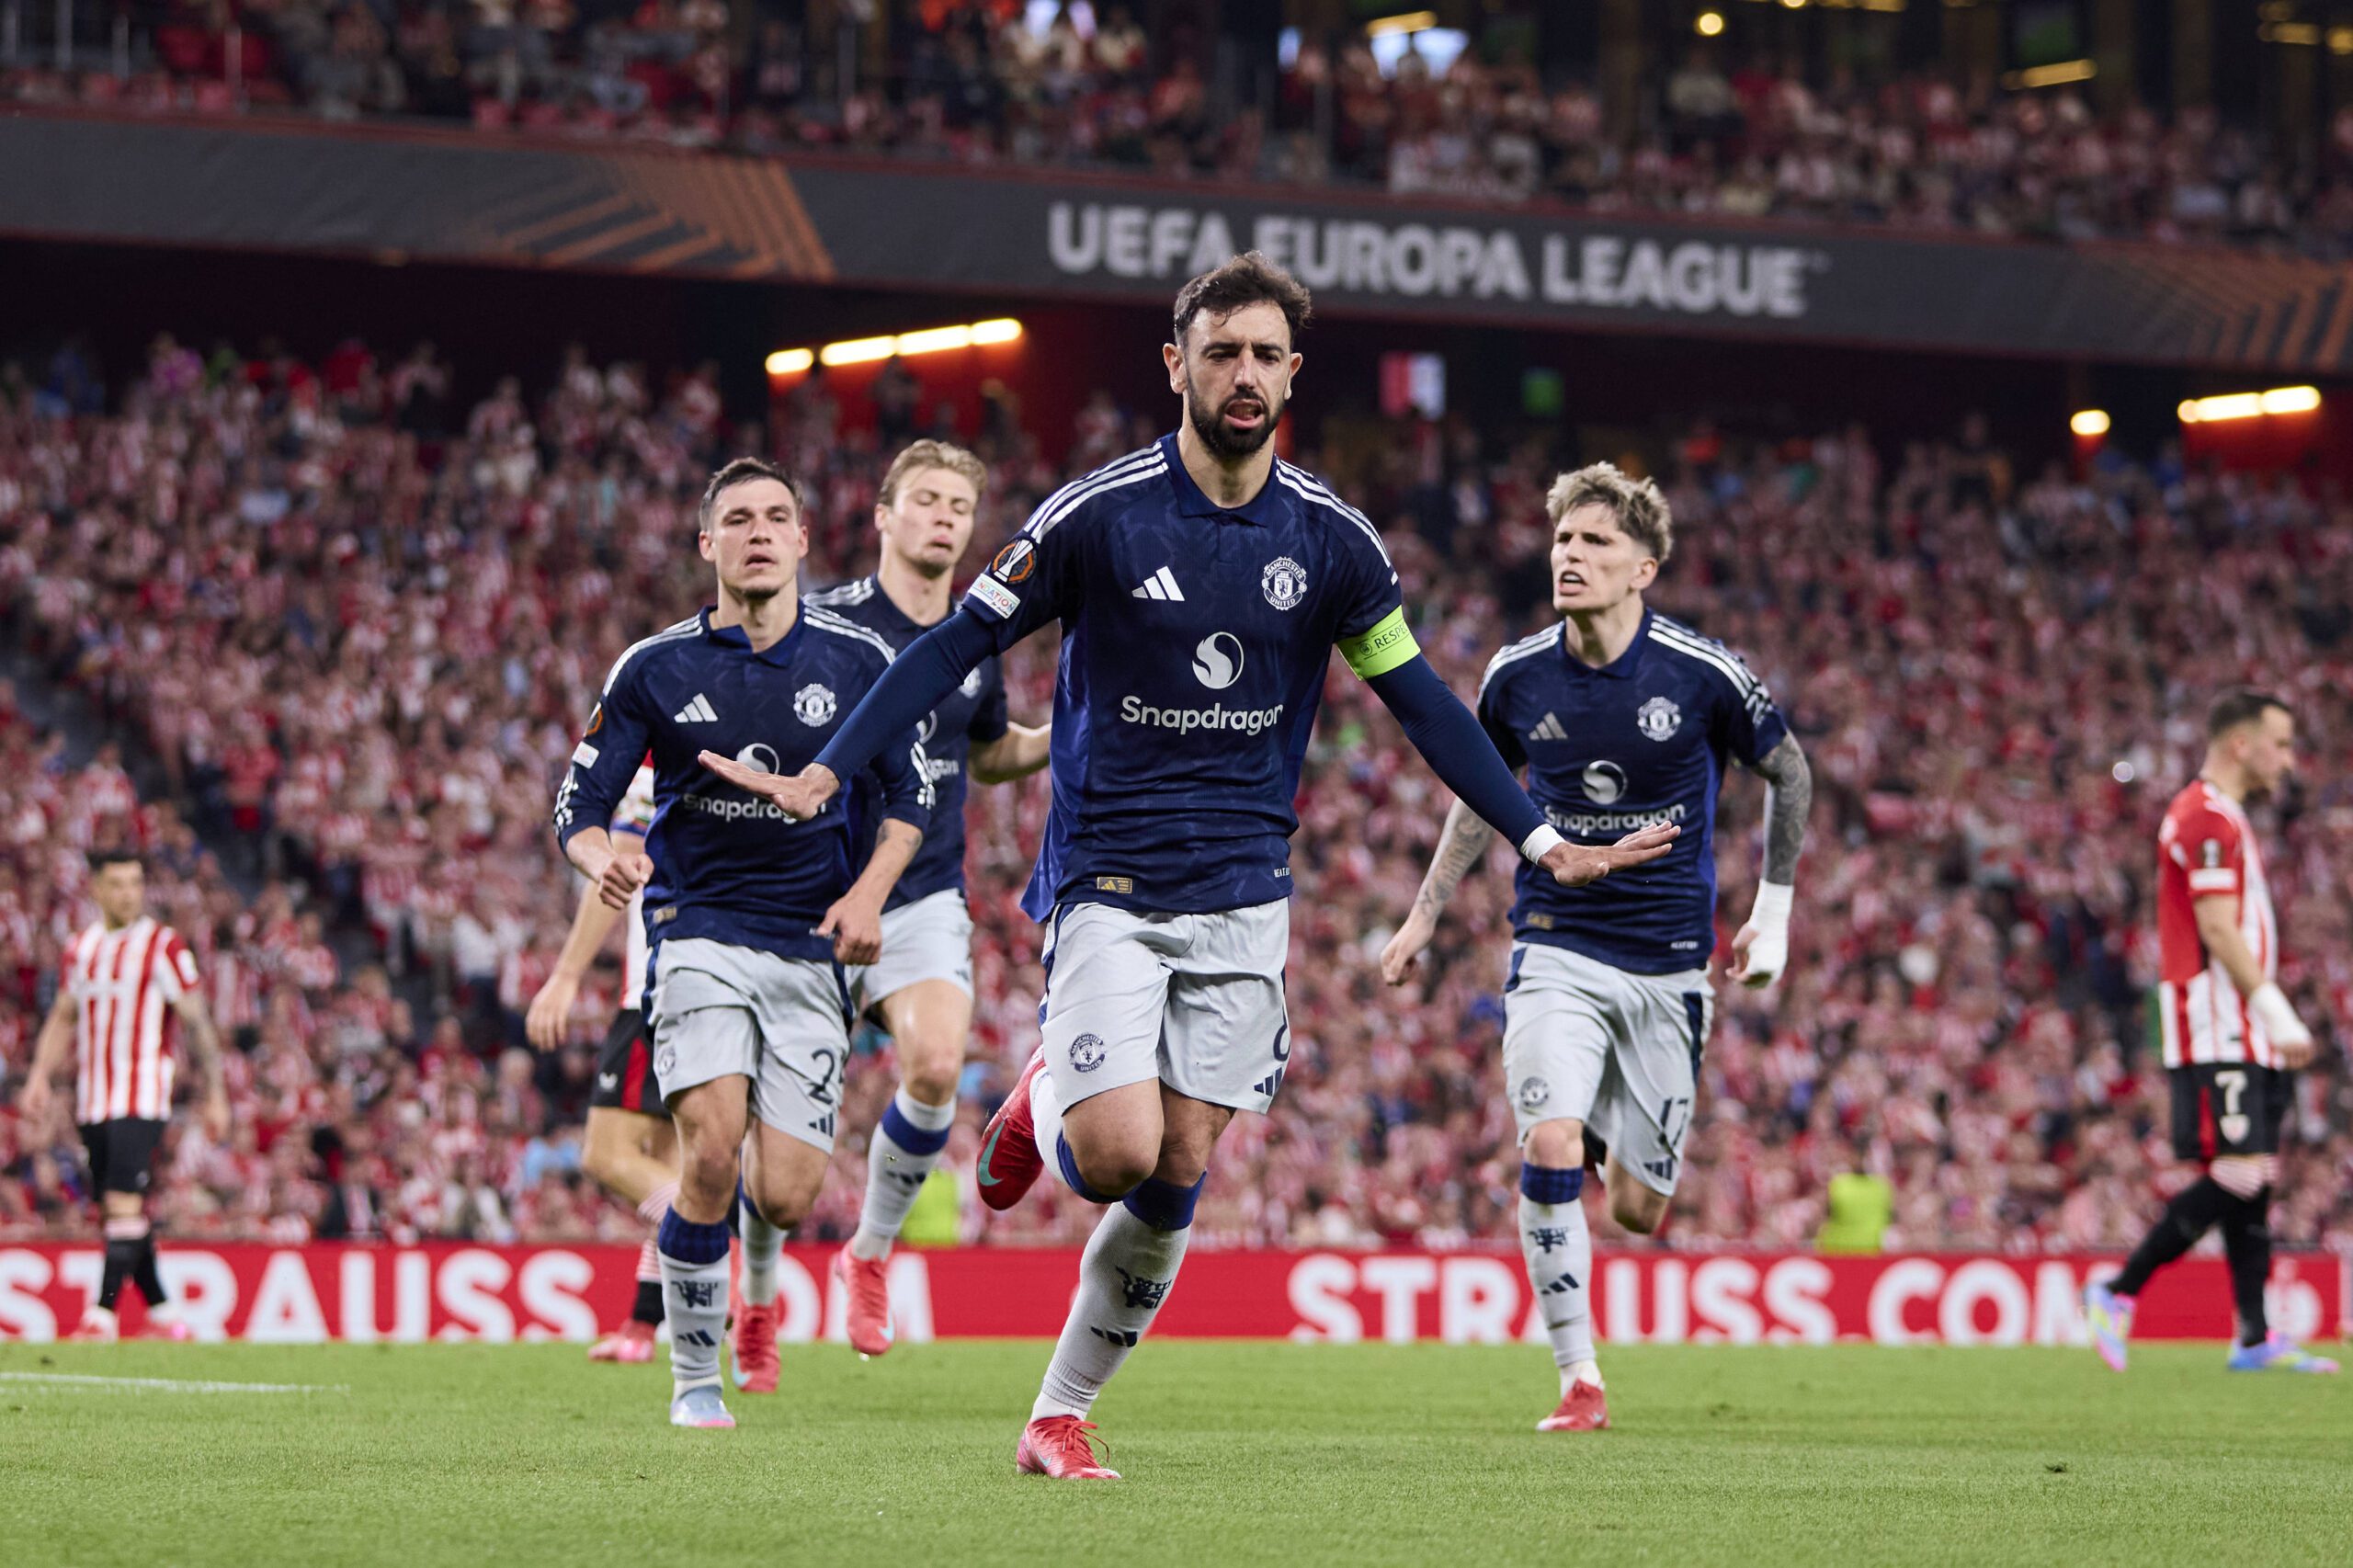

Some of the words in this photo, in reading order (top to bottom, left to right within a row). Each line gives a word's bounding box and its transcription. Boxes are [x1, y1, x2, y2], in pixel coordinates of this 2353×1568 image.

[1047, 203, 1236, 279] UEFA
[1253, 216, 1530, 302] EUROPA
[1540, 233, 1809, 318] LEAGUE
[1266, 561, 1303, 581] MANCHESTER
[1270, 596, 1296, 607] UNITED
[2214, 1070, 2248, 1115] 7
[1658, 1096, 1689, 1149] 17
